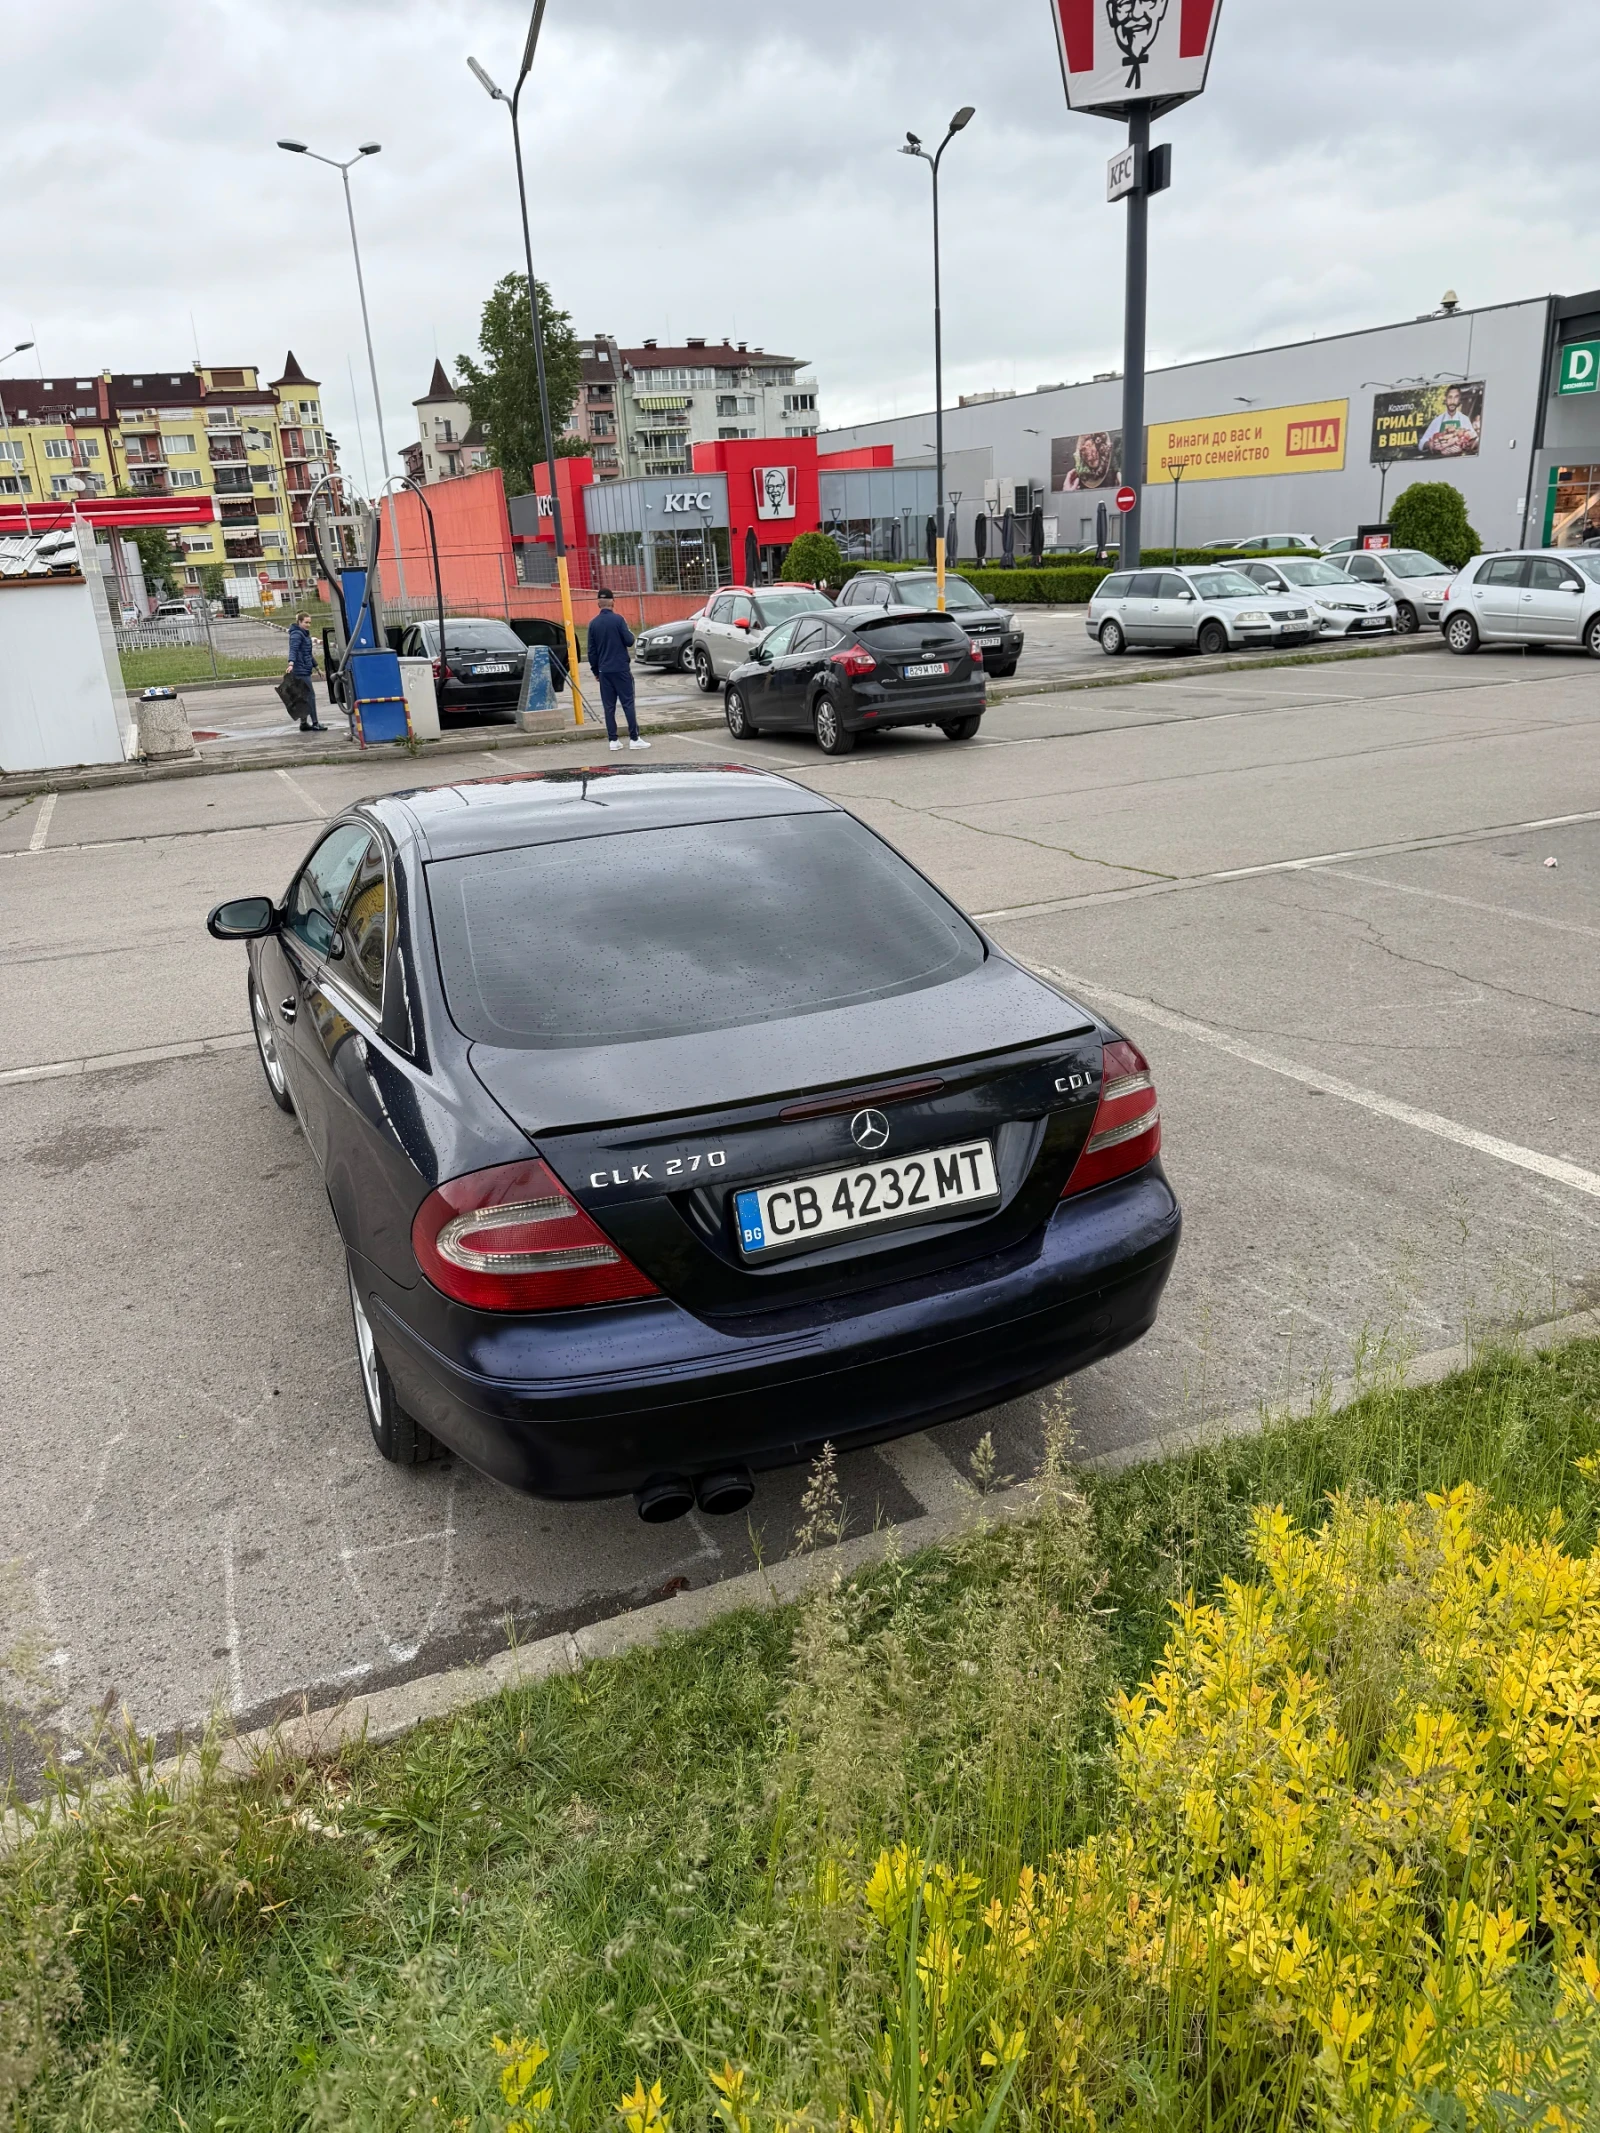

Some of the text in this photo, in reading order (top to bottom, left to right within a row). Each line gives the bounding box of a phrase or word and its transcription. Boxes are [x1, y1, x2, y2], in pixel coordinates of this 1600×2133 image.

[1110, 155, 1132, 189] KFC
[1569, 350, 1594, 380] D
[1376, 412, 1424, 431] ГРИЛА Е
[1168, 427, 1263, 449] Винаги до вас и
[1289, 424, 1336, 452] BILLA
[1379, 430, 1418, 448] В BILLA
[1161, 445, 1270, 469] вашето семейство
[663, 492, 712, 513] KFC
[909, 666, 923, 676] 829
[930, 664, 943, 673] 108
[1055, 1071, 1093, 1092] CDI
[590, 1150, 727, 1188] CLK 270
[767, 1148, 984, 1236] CB 4232 MT
[744, 1227, 762, 1243] BG
